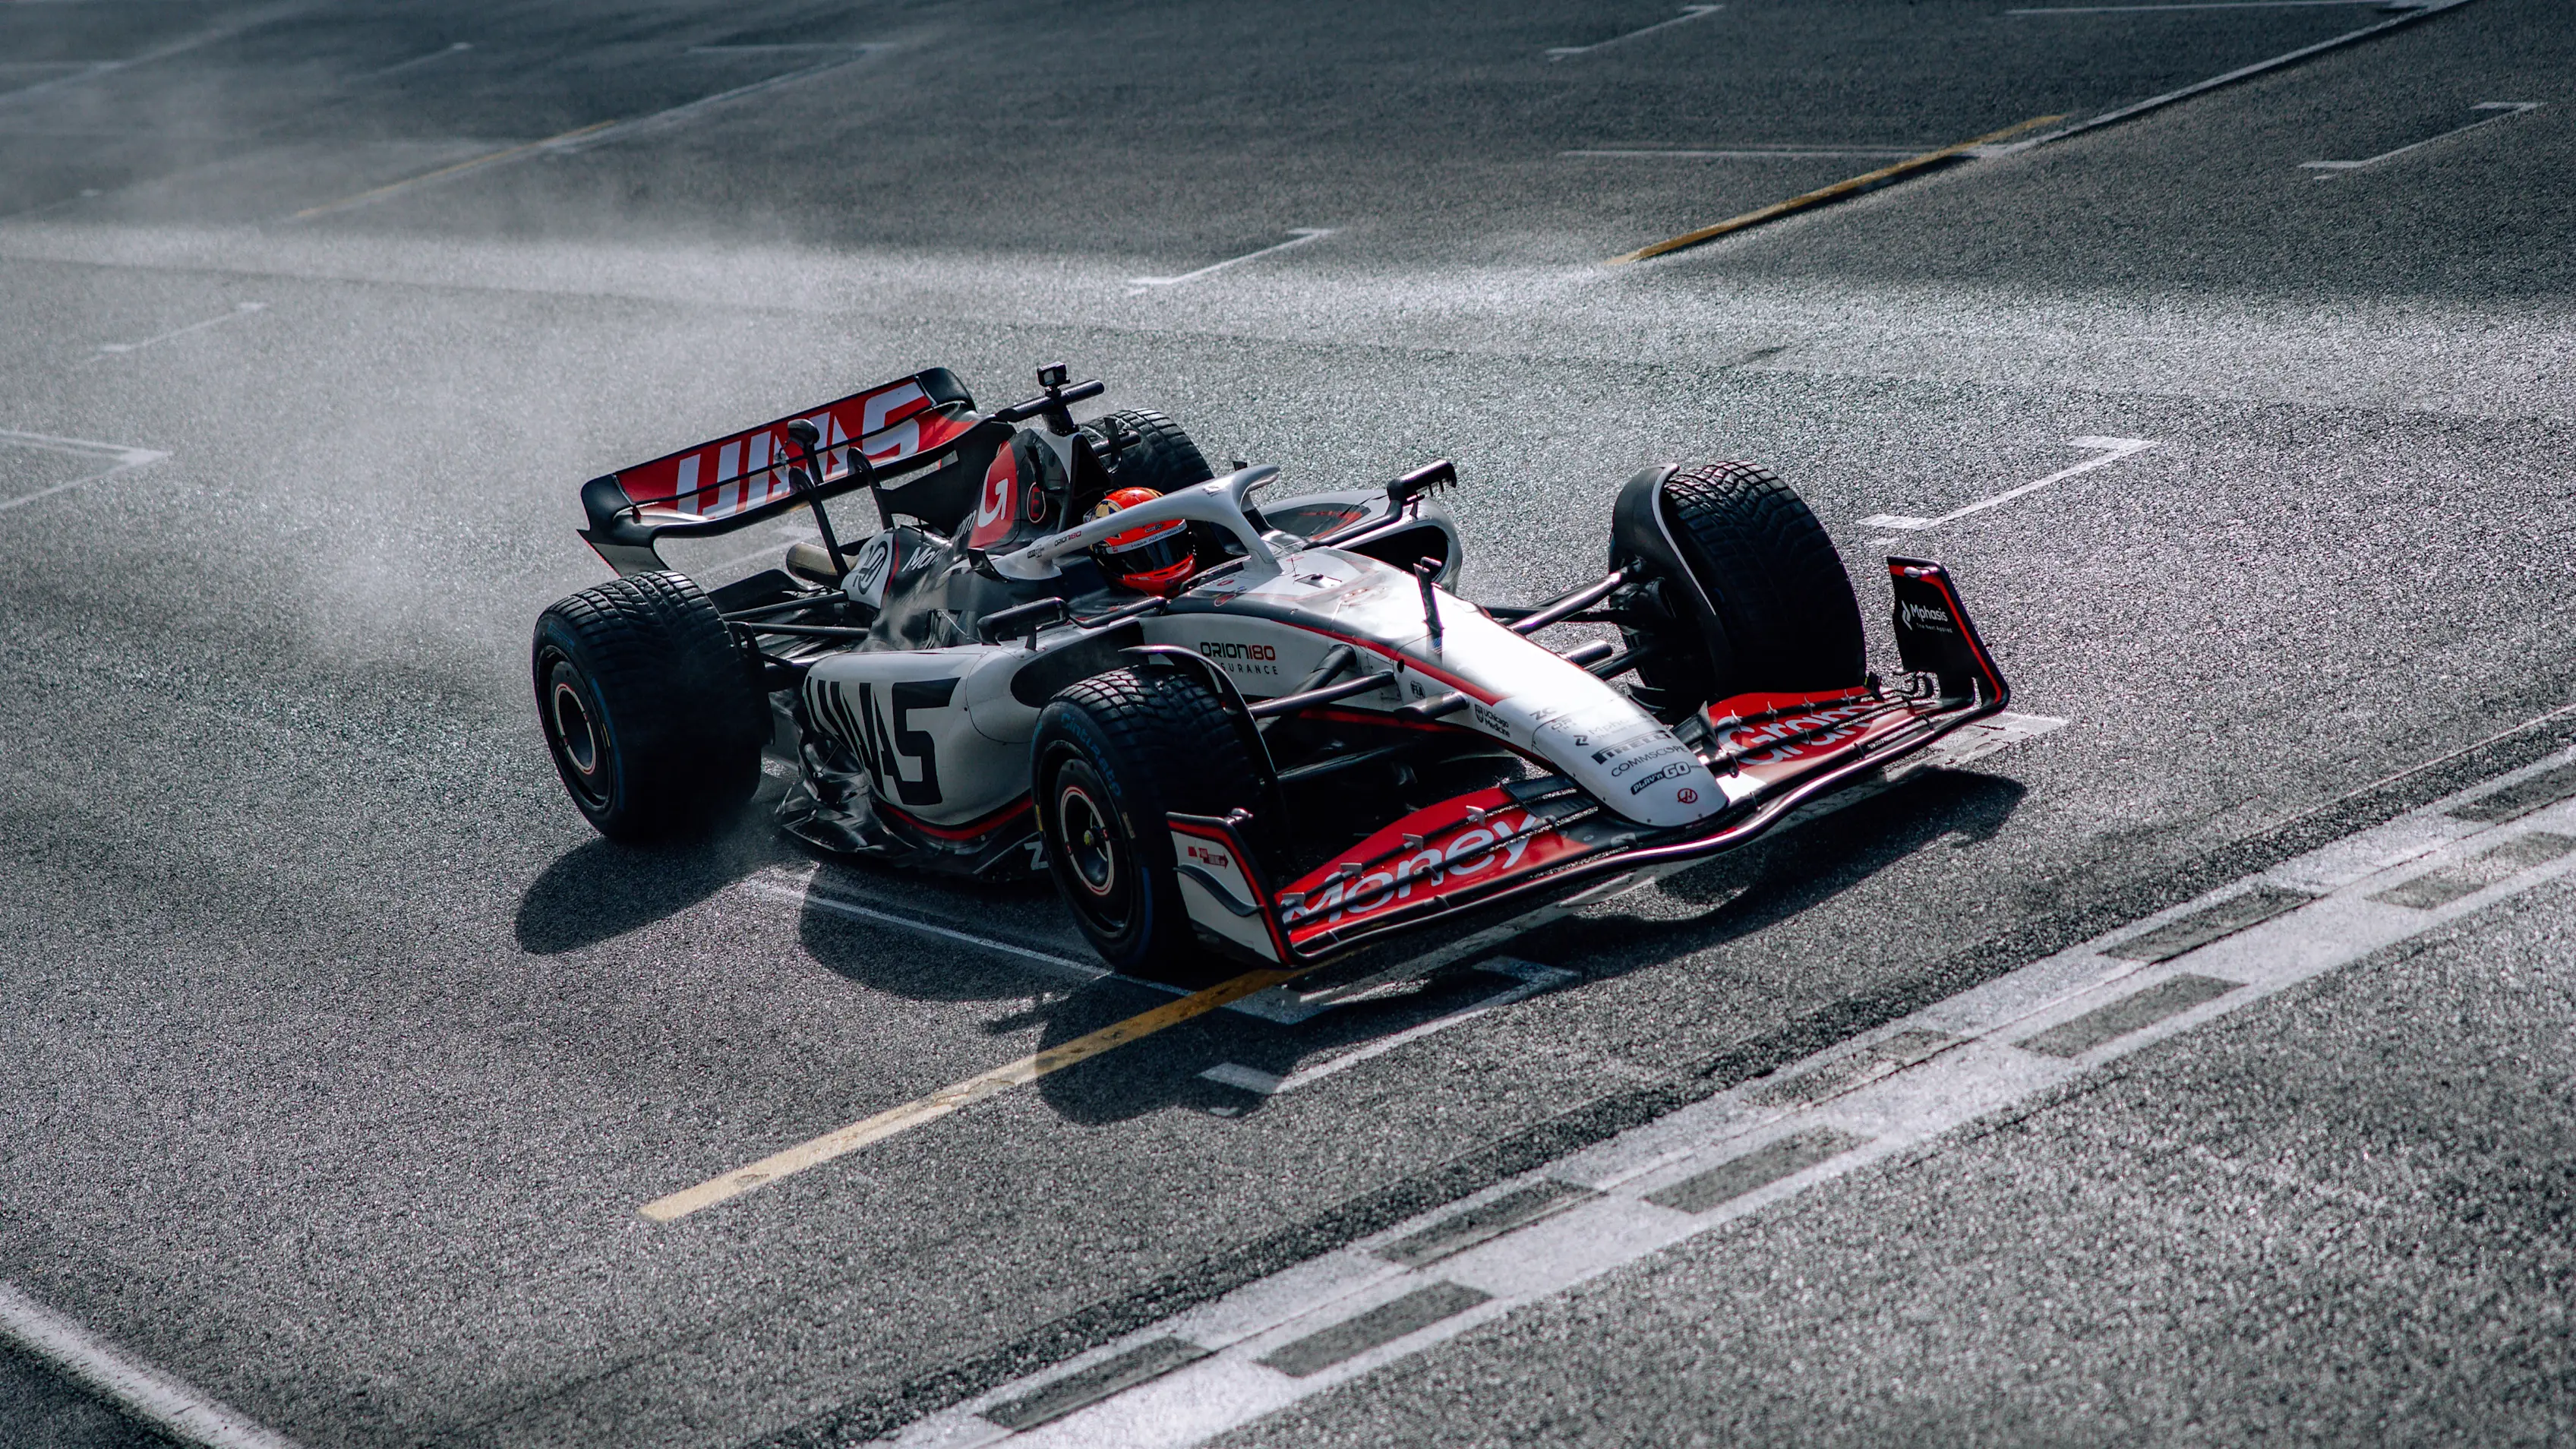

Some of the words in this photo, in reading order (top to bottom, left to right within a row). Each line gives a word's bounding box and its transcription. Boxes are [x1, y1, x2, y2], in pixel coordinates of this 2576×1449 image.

[1909, 603, 1949, 622] Mphasis
[1200, 642, 1276, 661] ORION180
[1485, 718, 1511, 737] Medicine
[1591, 730, 1672, 765] PIRELLI
[1612, 745, 1687, 777] COMMSCOPE
[1663, 762, 1690, 778] GO
[1280, 814, 1536, 924] Money
